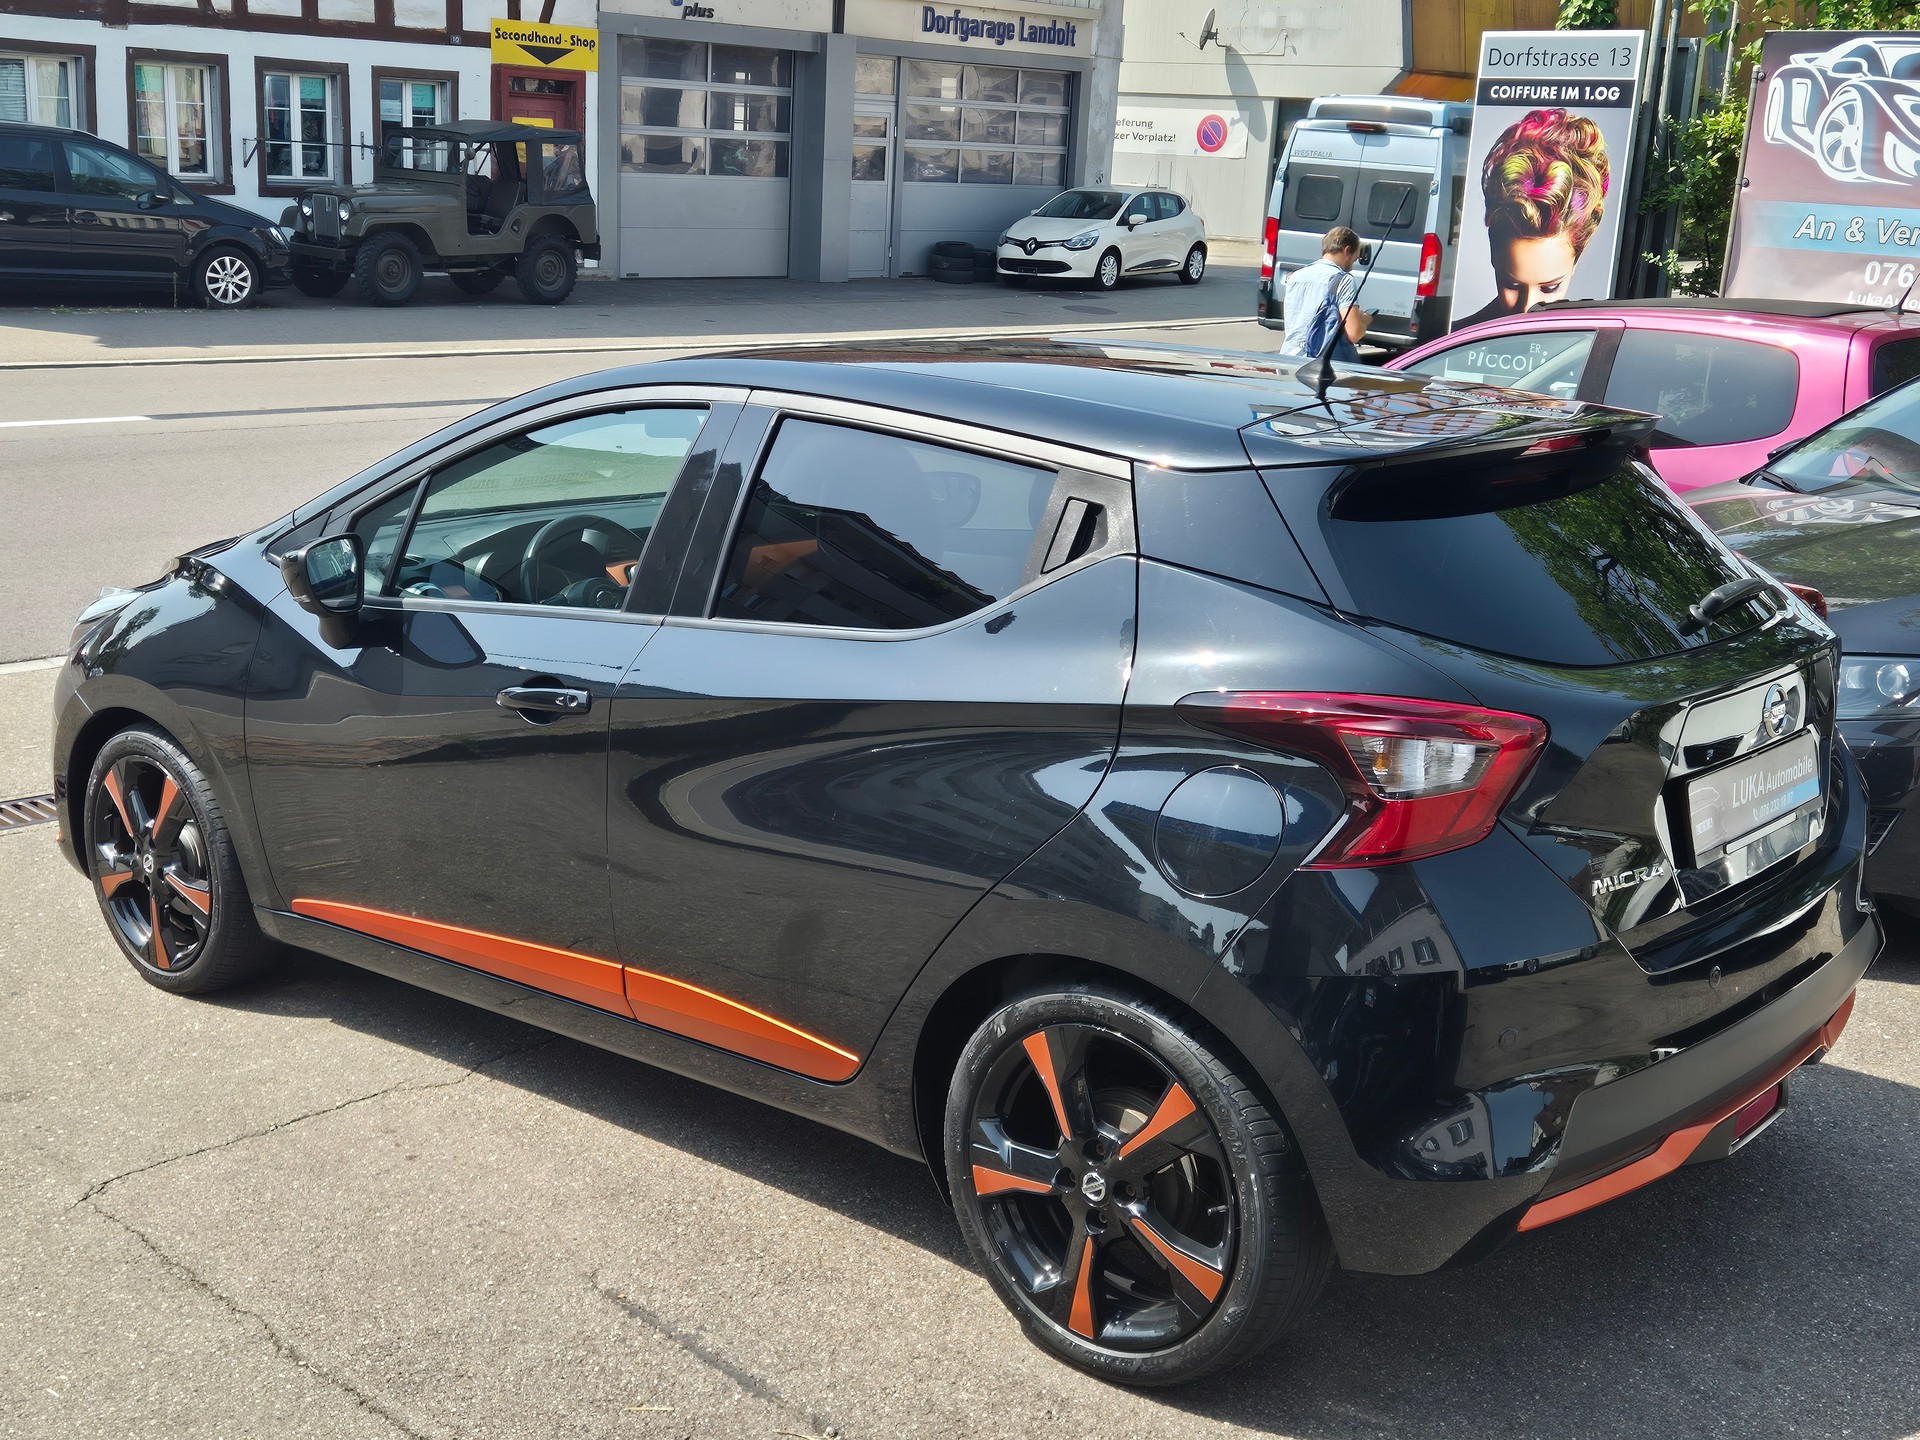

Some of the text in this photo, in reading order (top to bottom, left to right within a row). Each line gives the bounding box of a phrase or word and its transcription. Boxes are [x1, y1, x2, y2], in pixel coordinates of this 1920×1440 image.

[681, 2, 715, 20] plus
[922, 5, 1077, 47] Dorfgarage Landolt
[494, 27, 562, 45] Secondhand
[569, 34, 596, 50] Shop
[1488, 46, 1632, 67] Dorfstrasse 13
[1490, 85, 1557, 99] COIFFURE
[1560, 86, 1580, 100] IM
[1132, 131, 1176, 143] Vorplatz!
[1294, 149, 1333, 158] WESTFALIA
[1792, 213, 1920, 246] An & Ver
[1864, 260, 1916, 288] 076
[1732, 755, 1813, 809] LUKA Automobile
[1591, 863, 1665, 897] MICRA
